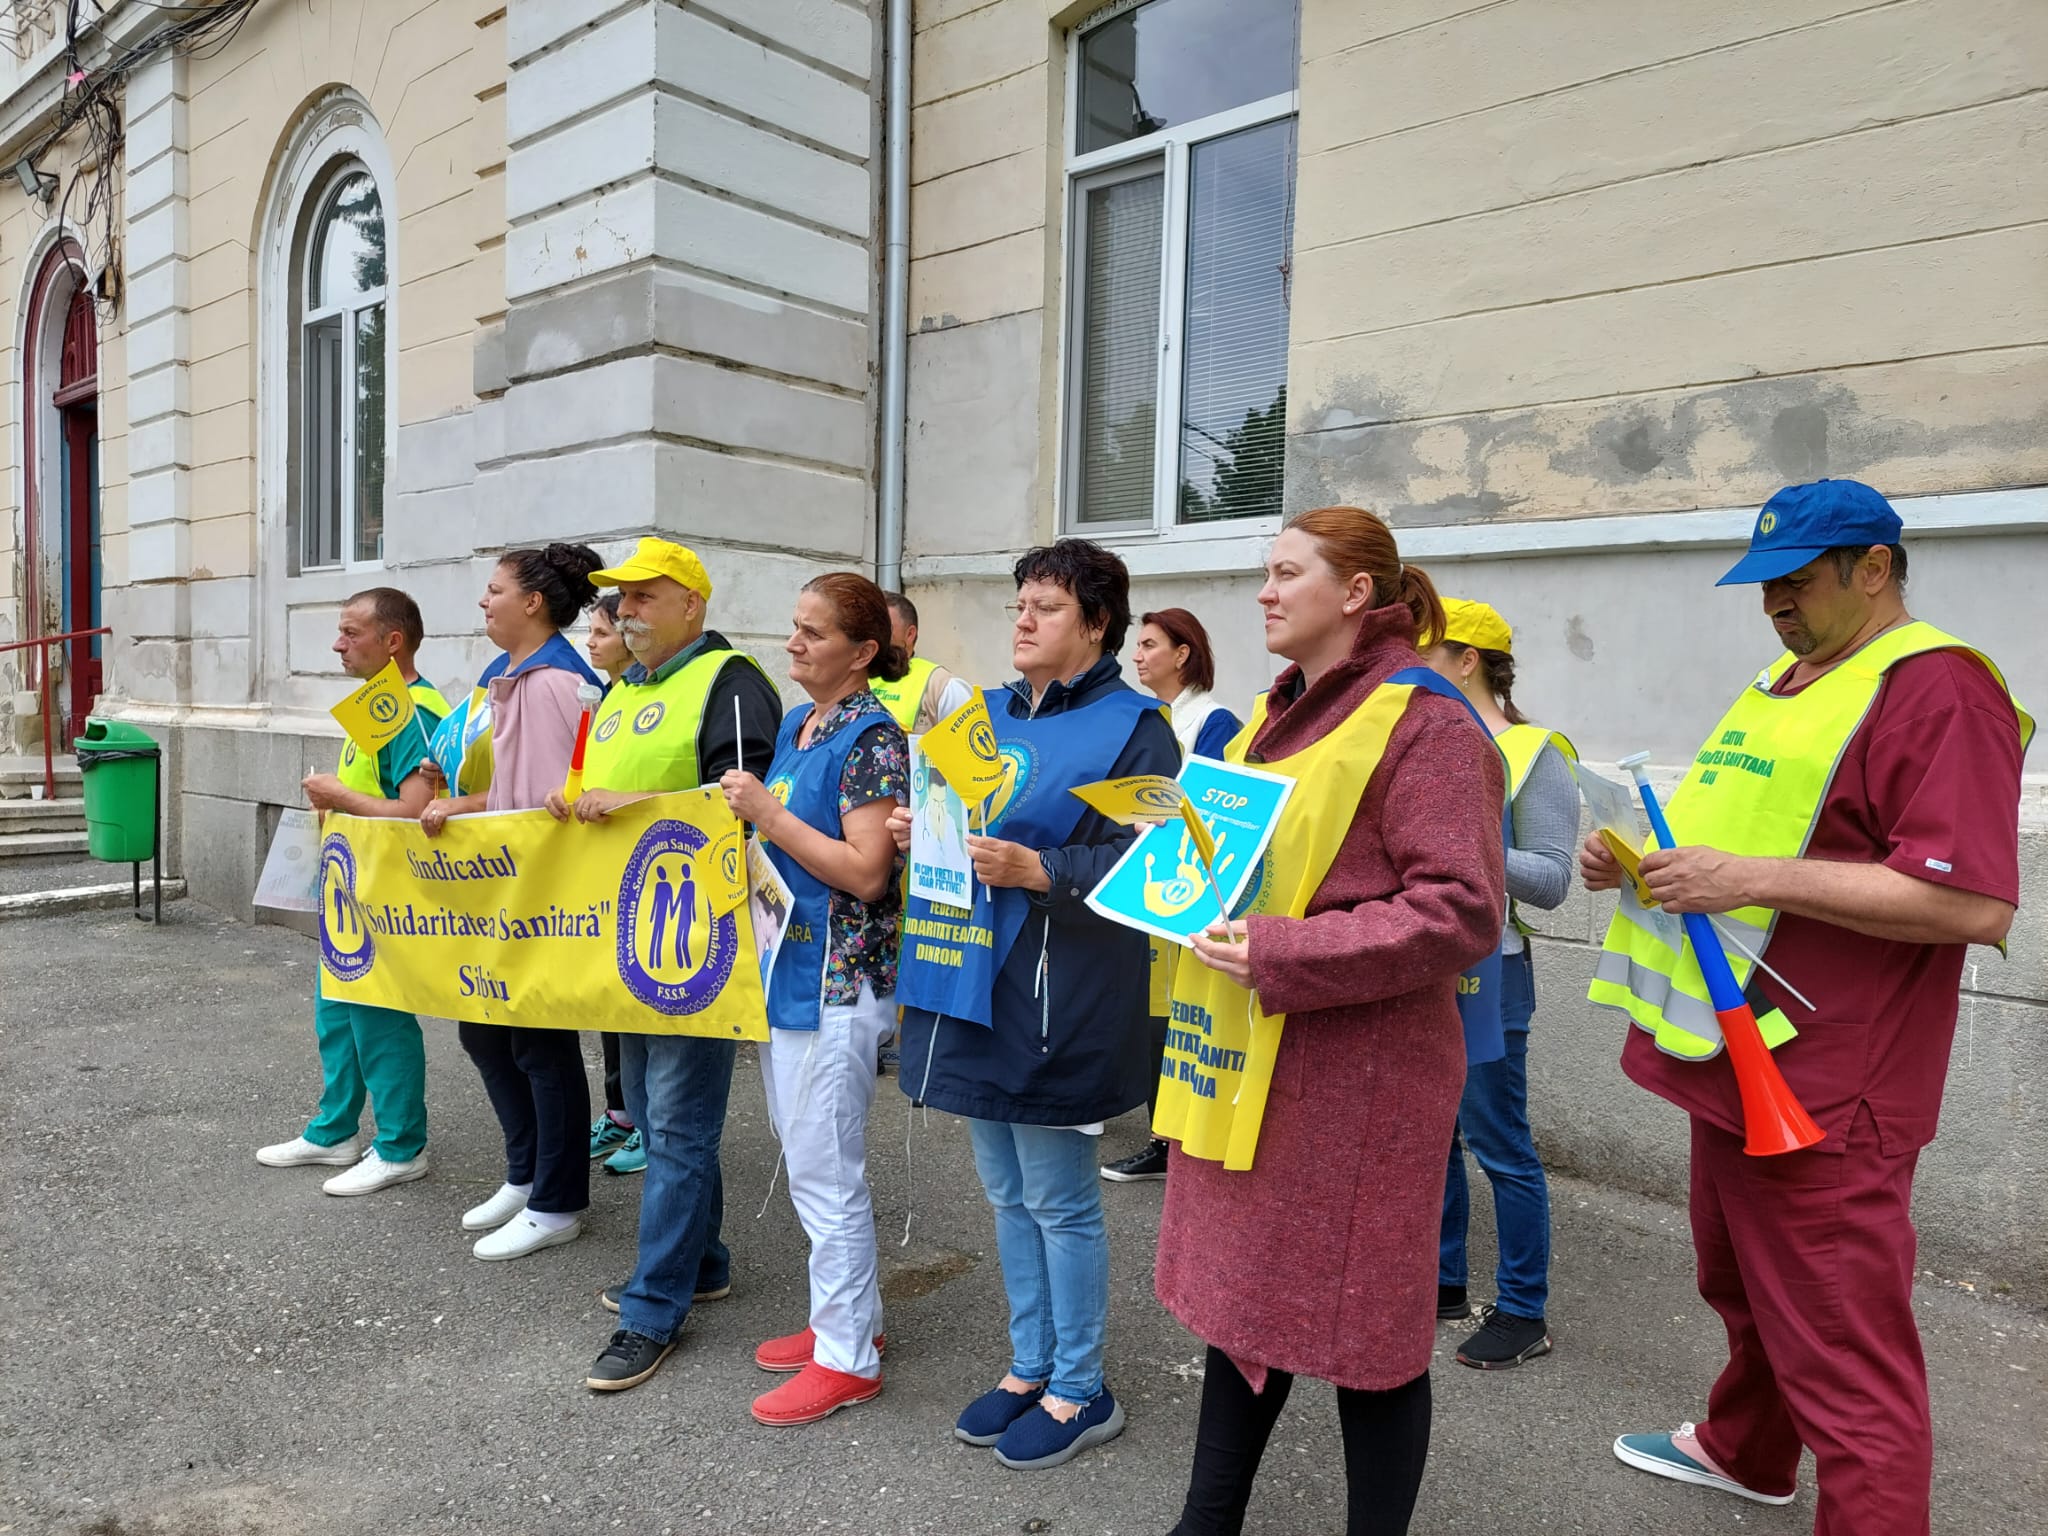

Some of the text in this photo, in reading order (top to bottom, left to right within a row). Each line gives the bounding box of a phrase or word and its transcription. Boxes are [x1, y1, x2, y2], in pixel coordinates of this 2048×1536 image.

[1201, 787, 1248, 811] STOP
[406, 844, 518, 881] Sindicatul
[499, 900, 610, 941] Sanitară"
[628, 901, 637, 966] Federația
[785, 921, 813, 944] ARĂ
[656, 985, 690, 1001] F.S.S.R.
